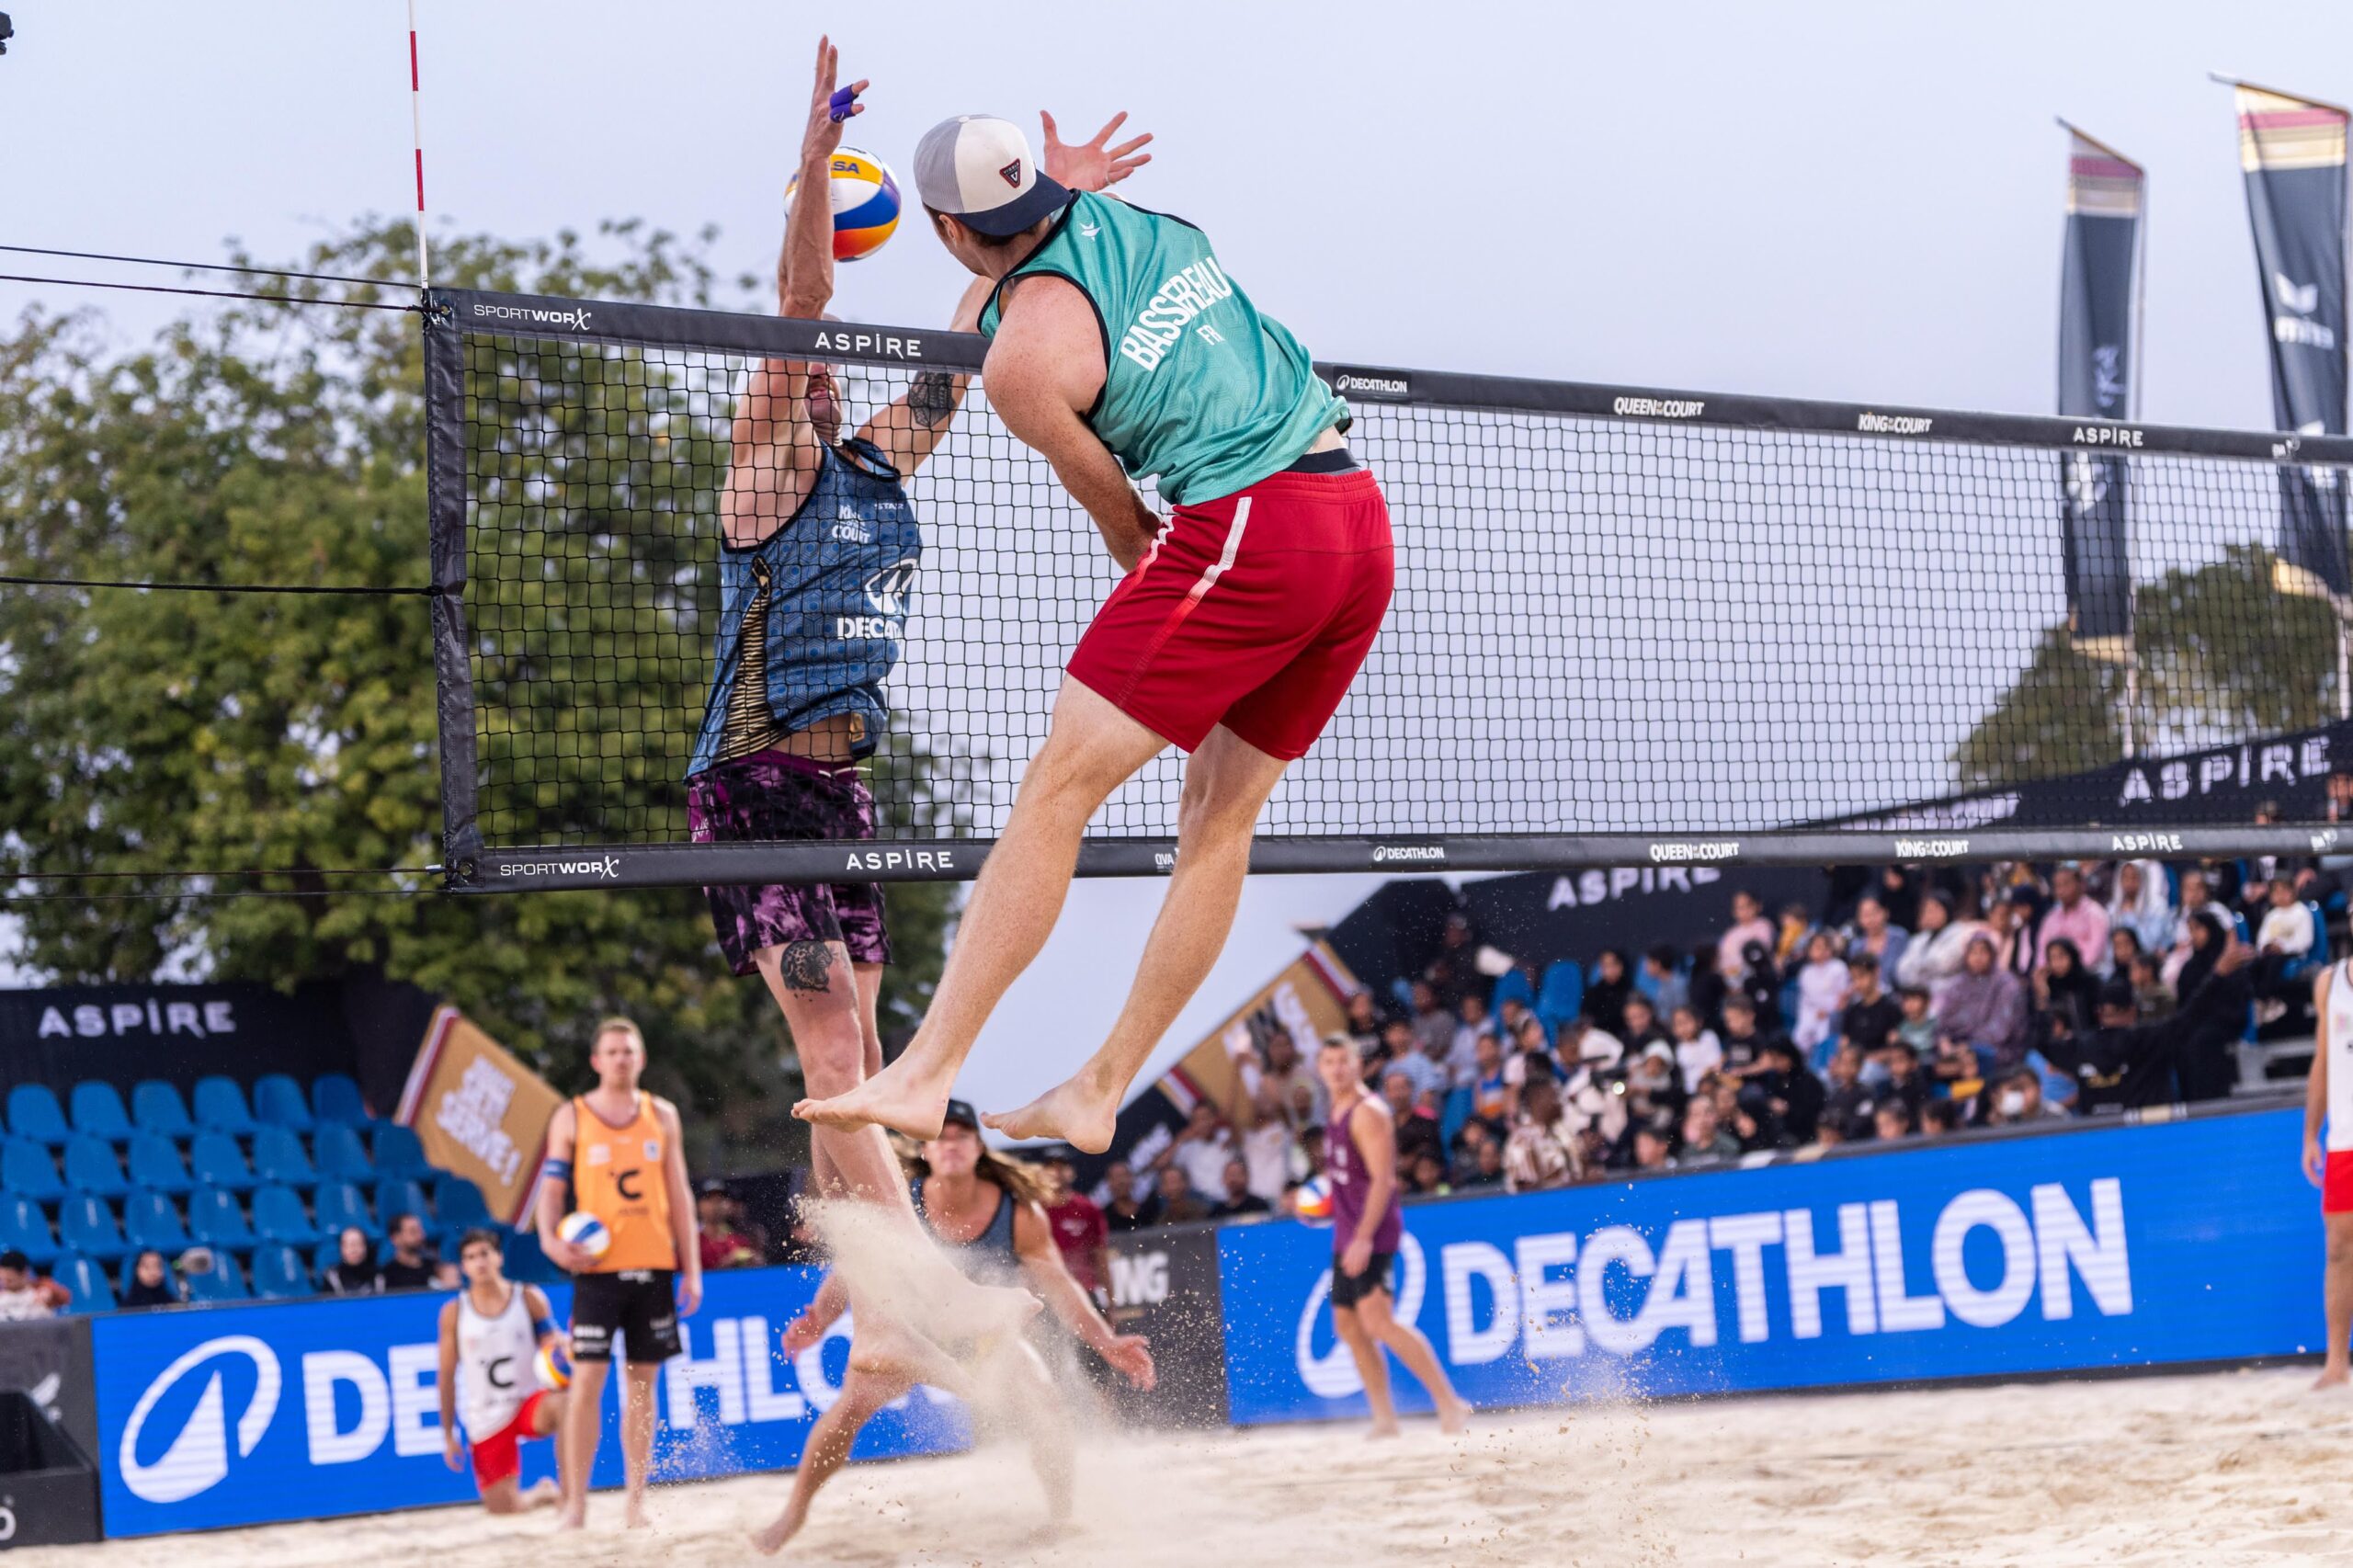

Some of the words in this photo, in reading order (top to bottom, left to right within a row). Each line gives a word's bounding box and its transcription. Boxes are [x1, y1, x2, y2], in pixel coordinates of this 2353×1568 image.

[473, 304, 592, 331] SPORTWORX
[814, 332, 922, 359] ASPIRE
[1350, 377, 1408, 392] DECATHLON
[1614, 397, 1657, 415] QUEEN
[1663, 400, 1705, 417] COURT
[1859, 414, 1889, 432] KING
[1894, 416, 1933, 434] COURT
[2073, 426, 2144, 449] ASPIRE
[2118, 735, 2333, 808] ASPIRE
[1387, 846, 1445, 859] DECATHLON
[1650, 844, 1693, 862] QUEEN
[1699, 842, 1740, 859] COURT
[1895, 841, 1927, 858] KING
[1931, 839, 1970, 857] COURT
[2112, 833, 2184, 853] ASPIRE
[500, 855, 620, 880] SPORTWORX
[846, 849, 954, 872] ASPIRE
[38, 998, 236, 1039] ASPIRE
[1441, 1176, 2133, 1366] DECATHLON
